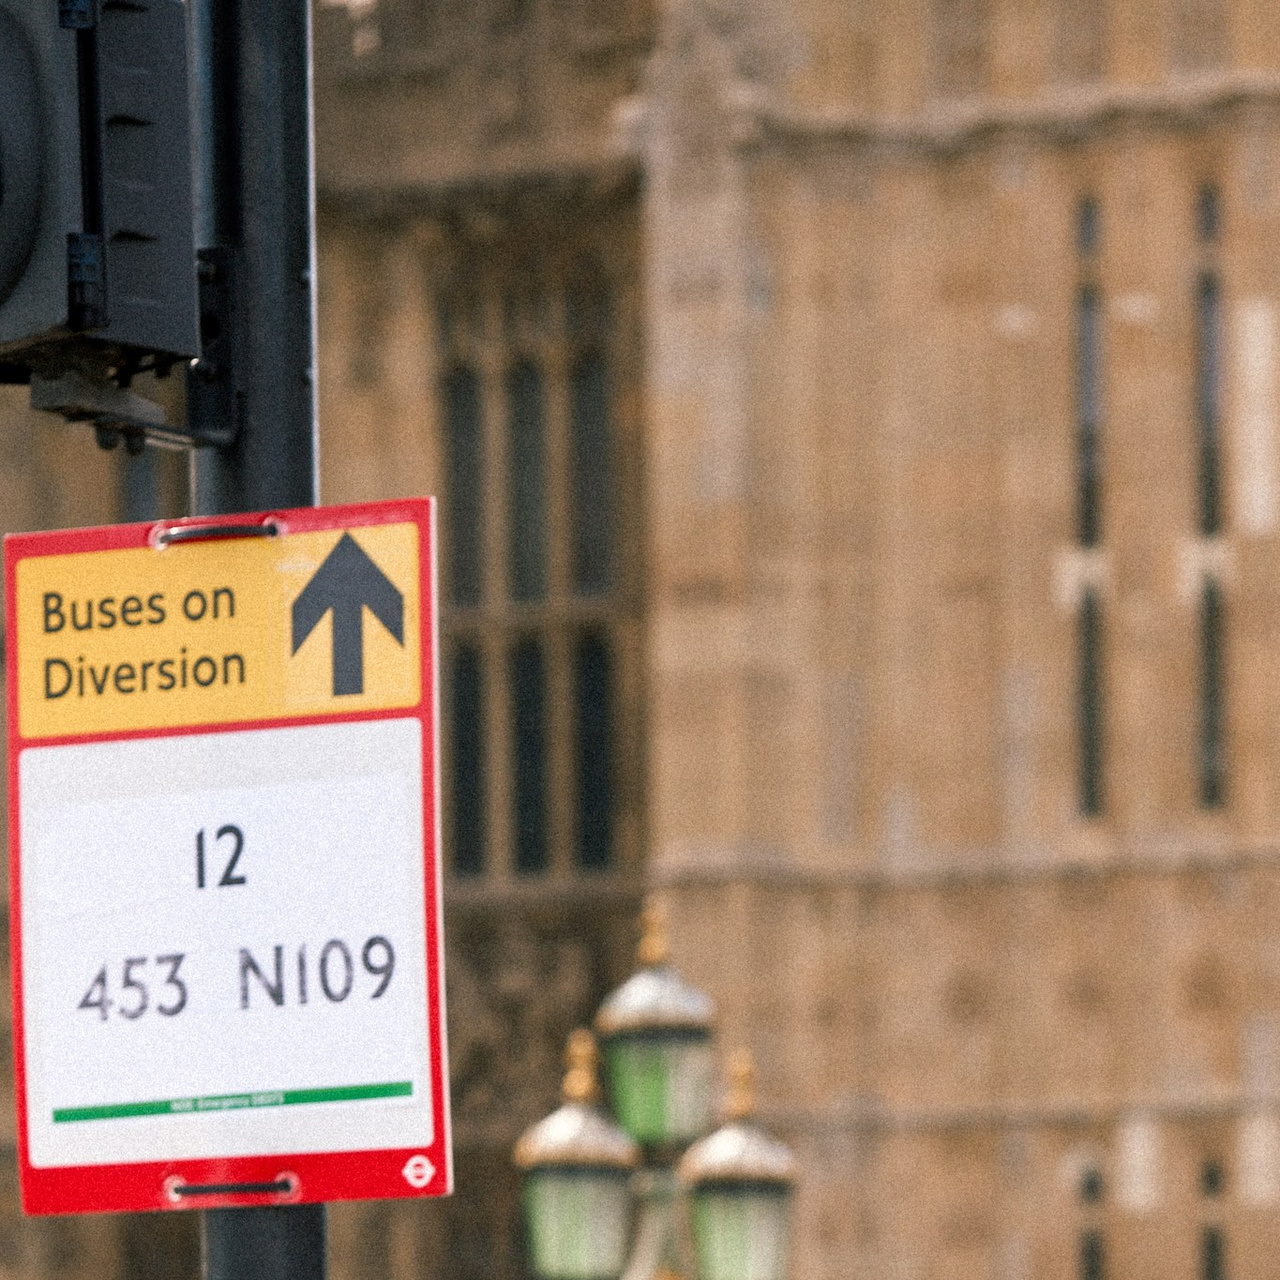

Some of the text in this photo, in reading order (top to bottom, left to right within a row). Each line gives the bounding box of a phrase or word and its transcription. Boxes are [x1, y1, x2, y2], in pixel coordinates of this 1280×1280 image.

[43, 586, 235, 633] Buses on
[45, 648, 246, 699] Diversion
[195, 824, 247, 889] 12
[78, 935, 395, 1021] 453 N109
